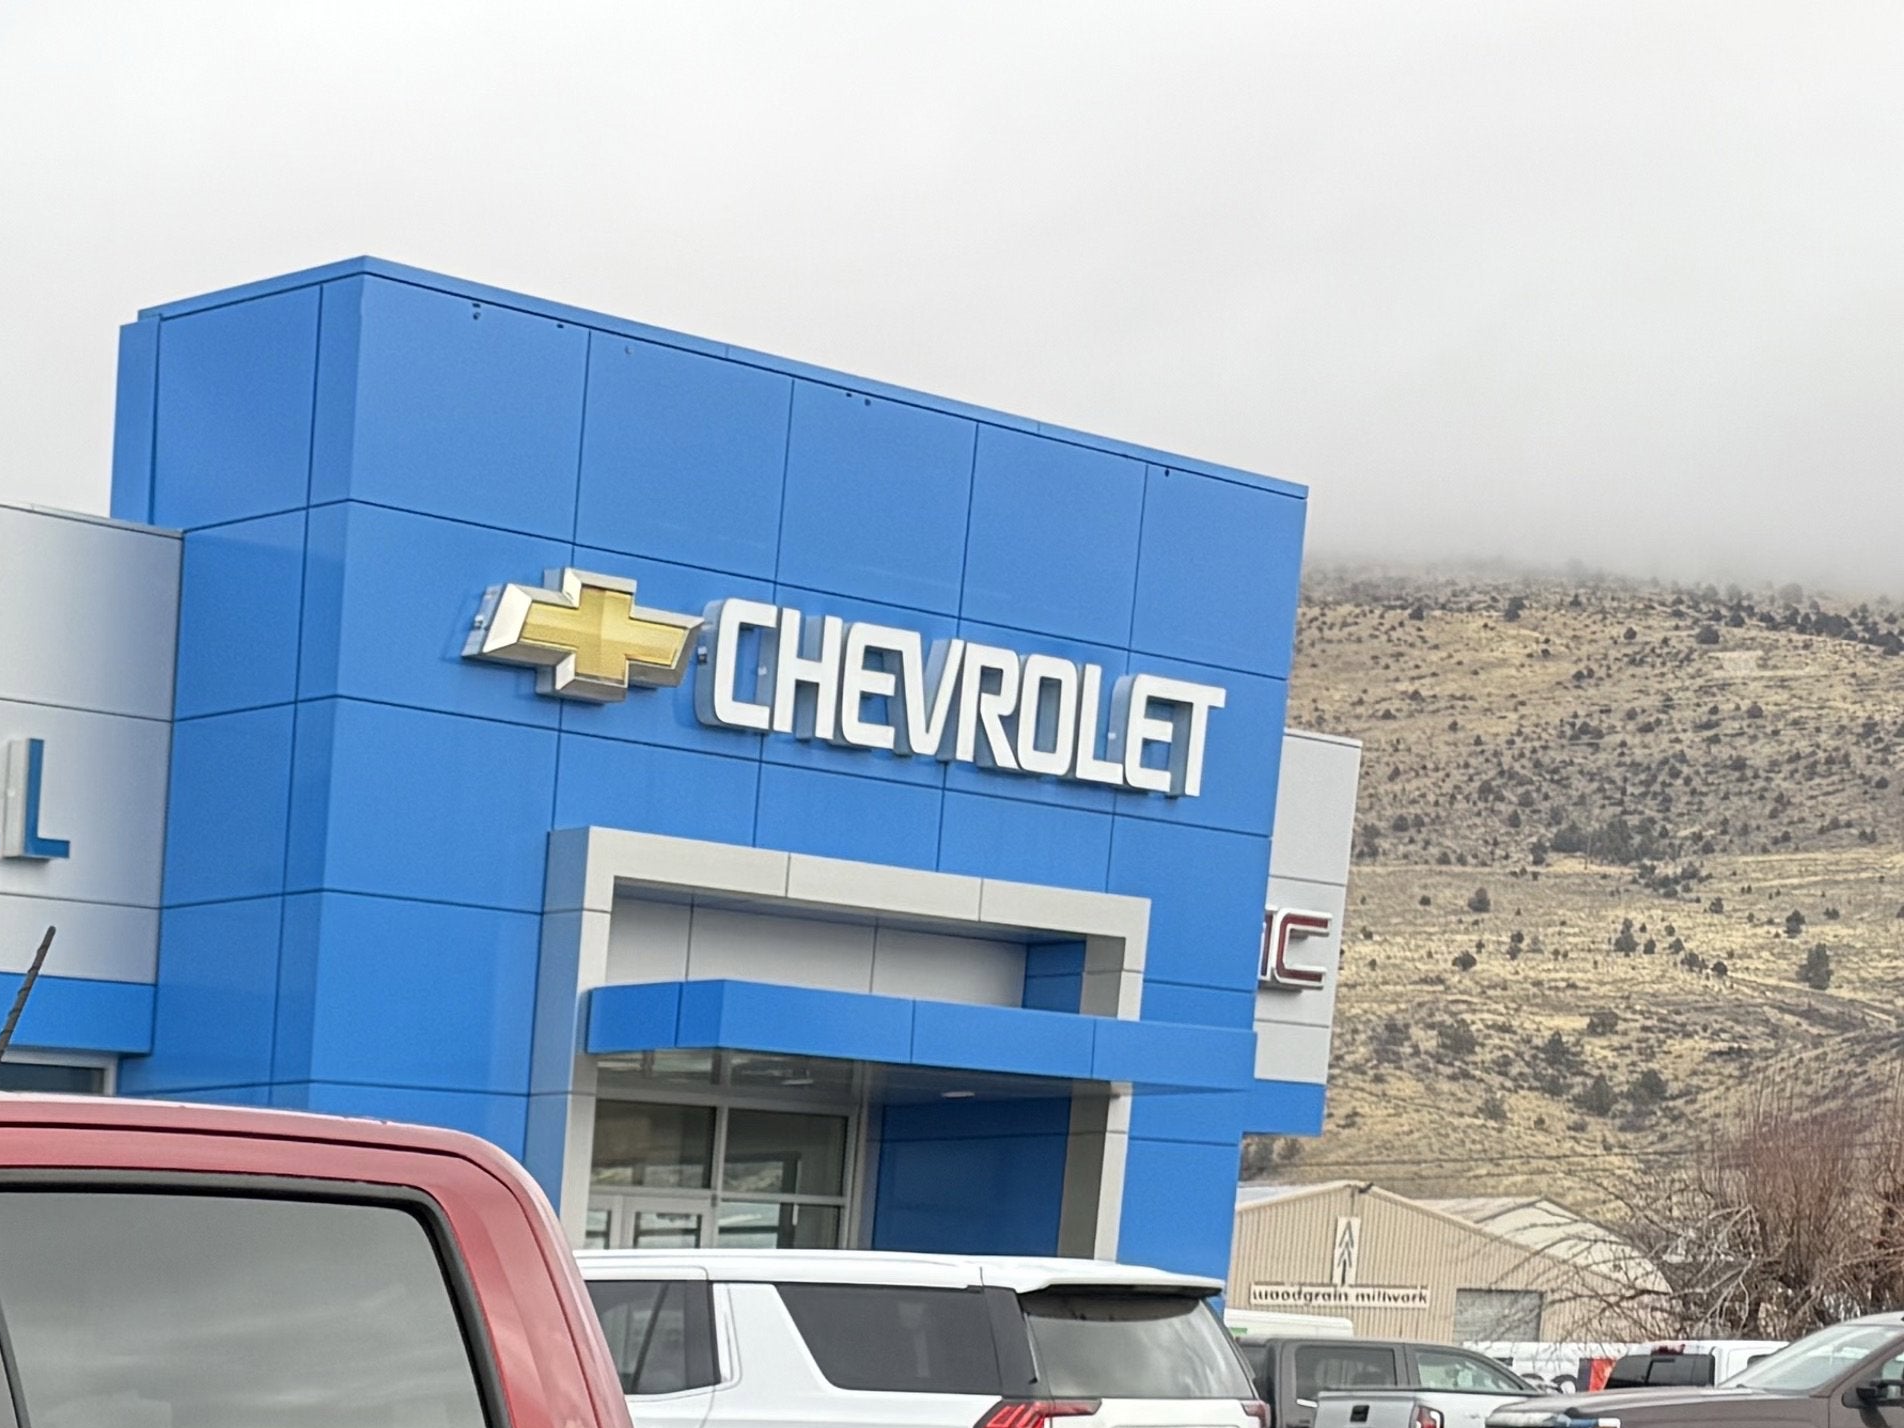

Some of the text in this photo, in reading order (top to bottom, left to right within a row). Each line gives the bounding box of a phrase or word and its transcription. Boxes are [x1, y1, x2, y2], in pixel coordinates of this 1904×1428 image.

[702, 597, 1227, 798] CHEVROLET
[1252, 1285, 1428, 1304] woodgrain millwork
